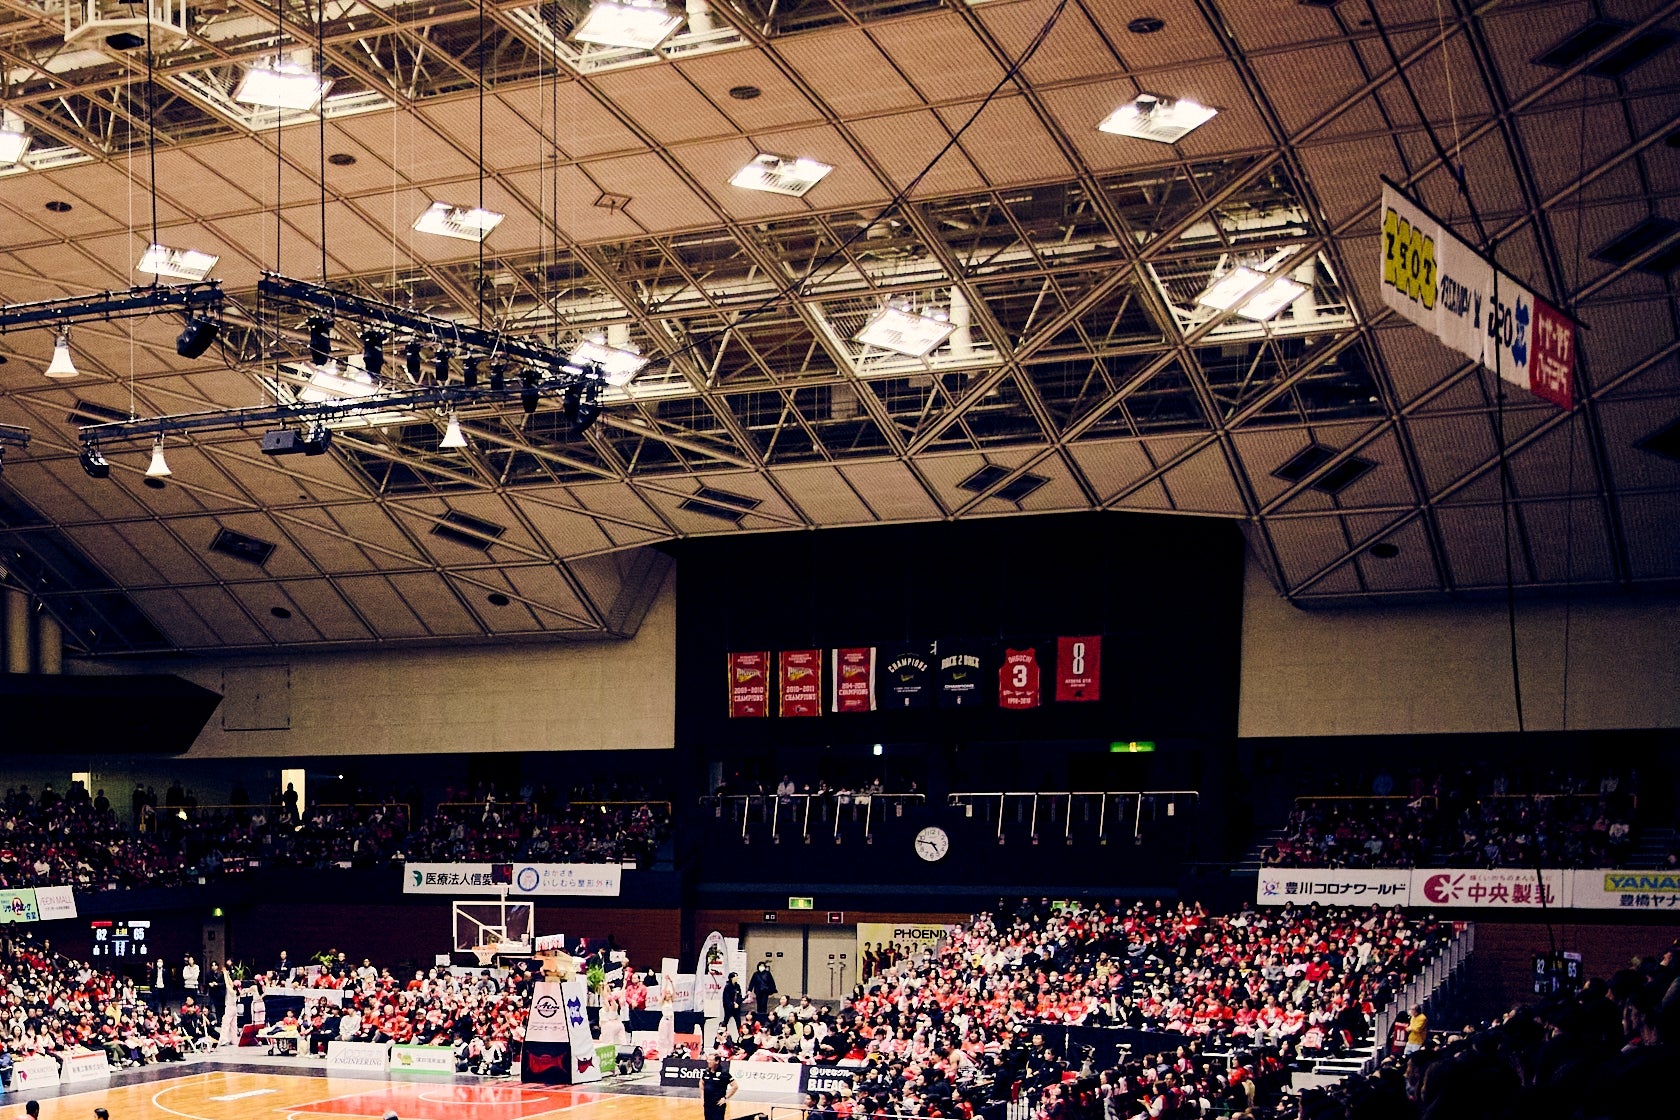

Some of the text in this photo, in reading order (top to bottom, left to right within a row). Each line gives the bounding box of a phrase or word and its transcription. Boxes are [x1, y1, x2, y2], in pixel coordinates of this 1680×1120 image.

[888, 658, 928, 673] CHAMPIONS
[1073, 642, 1085, 675] 8
[1013, 665, 1027, 687] 3
[734, 694, 764, 702] CHAMPIONS
[785, 693, 816, 701] CHAMPIONS
[1285, 881, 1406, 896] 豊川コロナワールド
[1611, 877, 1680, 889] YANA
[1468, 883, 1554, 903] 中央製乳
[96, 928, 107, 941] 82
[1536, 958, 1545, 975] 82
[745, 1070, 794, 1081] りそなグループ
